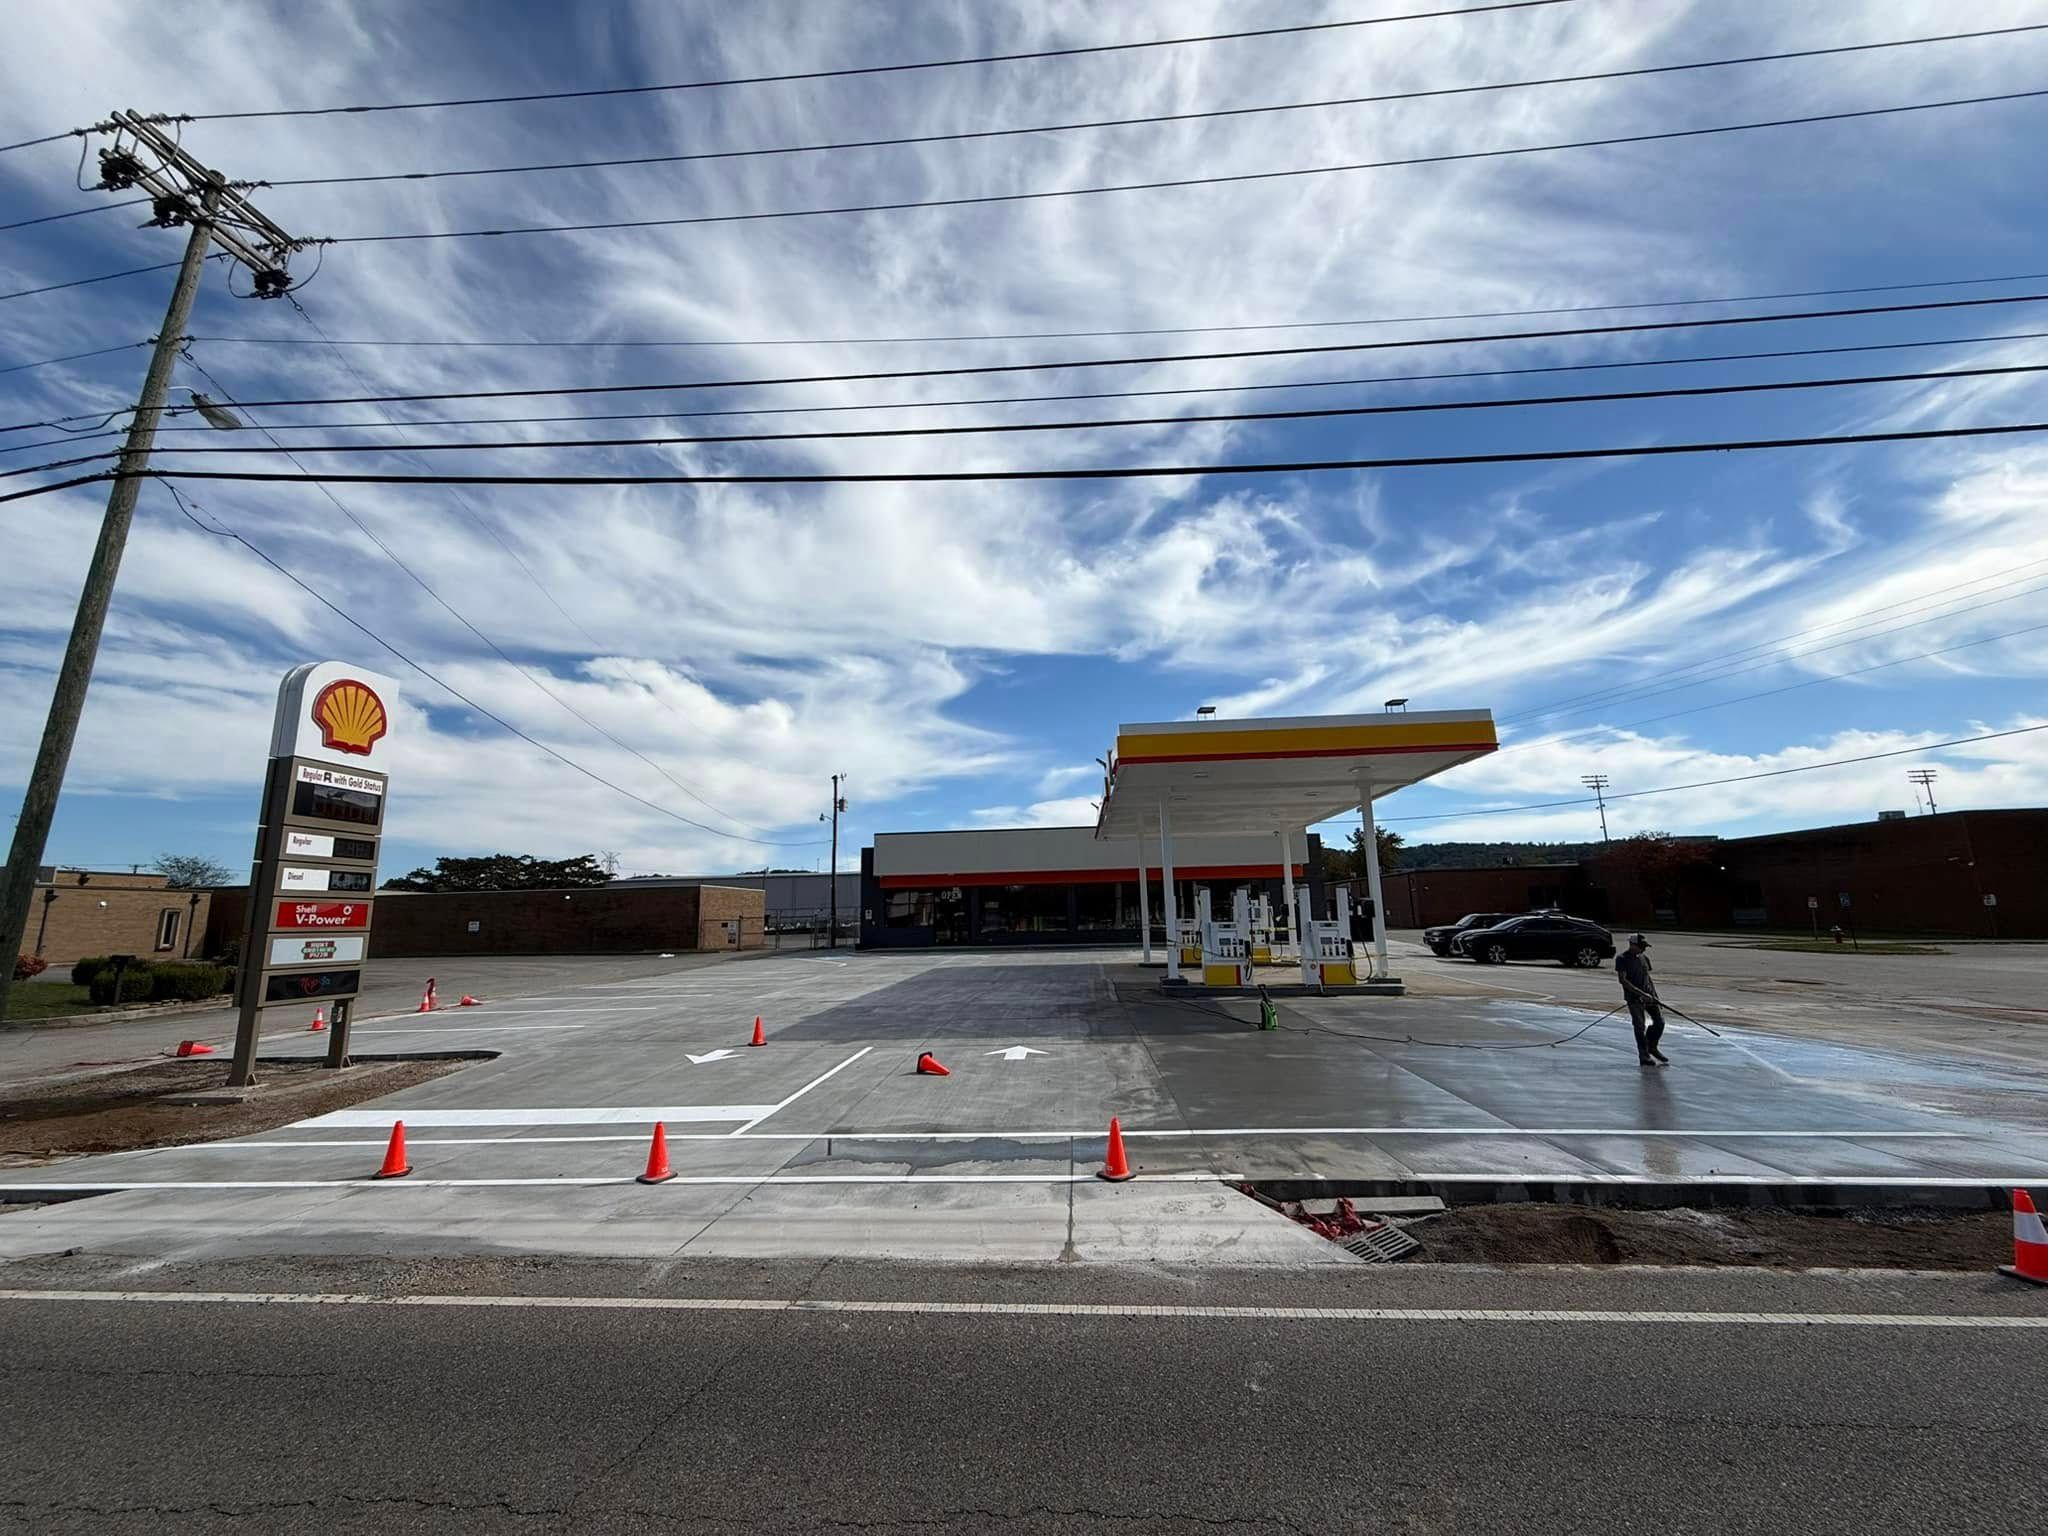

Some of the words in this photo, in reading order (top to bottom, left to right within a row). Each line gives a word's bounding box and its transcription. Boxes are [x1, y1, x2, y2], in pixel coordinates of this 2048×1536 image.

[303, 768, 323, 782] Regular
[334, 775, 347, 786] with
[348, 777, 363, 789] Gold
[363, 780, 382, 792] Status
[293, 836, 312, 847] Regular
[287, 872, 304, 880] Diesel
[296, 905, 317, 914] Shell
[296, 914, 347, 925] V-Power
